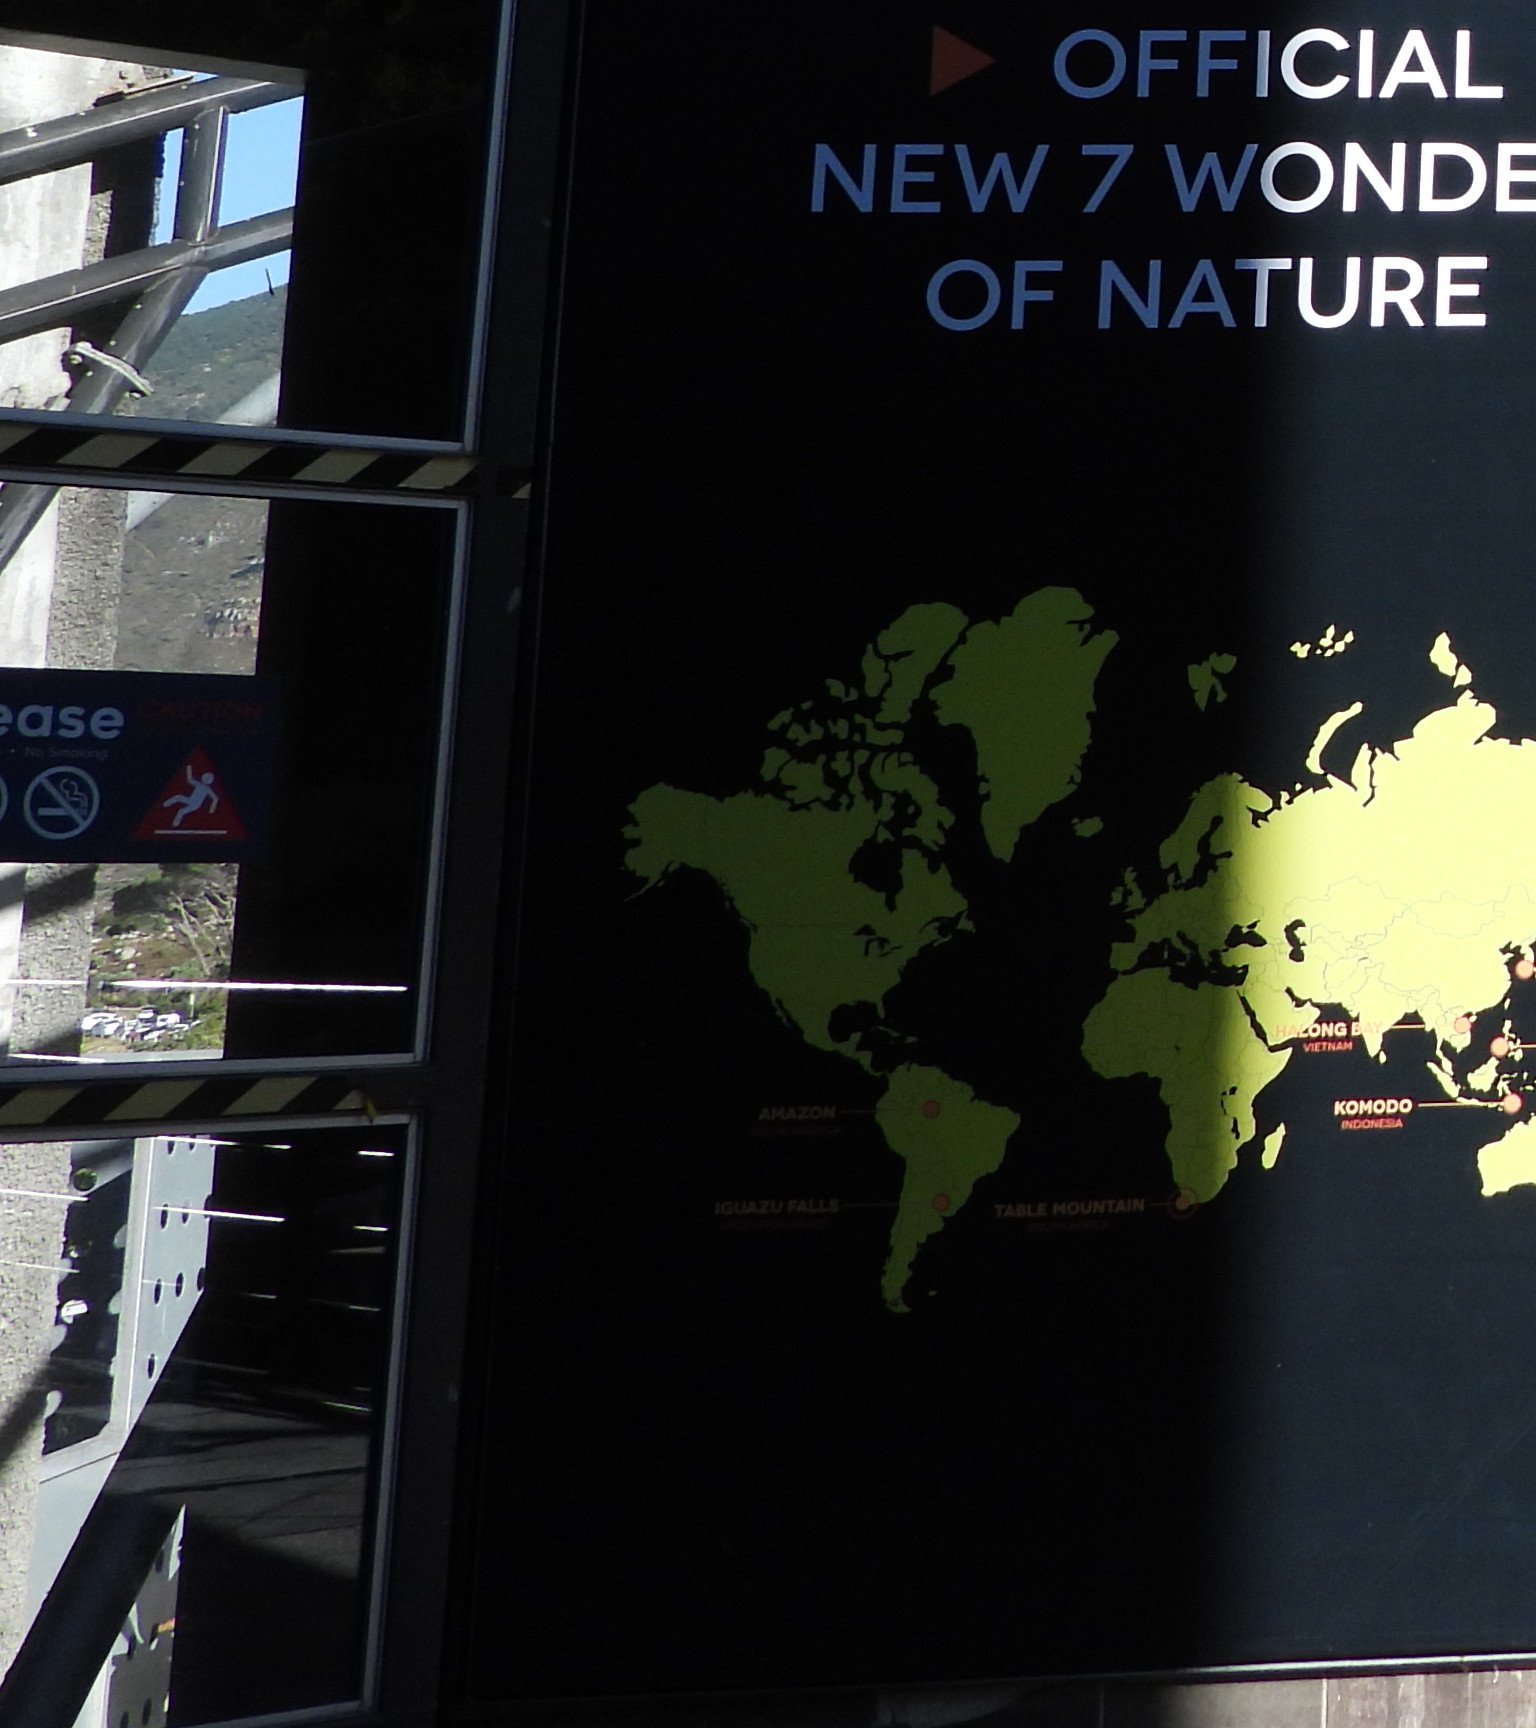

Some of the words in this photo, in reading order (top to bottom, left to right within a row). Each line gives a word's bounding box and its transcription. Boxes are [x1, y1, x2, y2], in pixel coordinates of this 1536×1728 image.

[1053, 27, 1504, 101] OFFICIAL
[811, 143, 1050, 214] NEW
[1080, 144, 1134, 214] 7
[926, 258, 1063, 332] OF
[1098, 256, 1489, 330] NATURE
[1275, 1021, 1348, 1038] HALONG
[1351, 1021, 1383, 1037] BAY
[1303, 1041, 1353, 1052] VIETNAM
[758, 1105, 837, 1121] AMAZON
[1334, 1099, 1413, 1115] KOMODO
[1341, 1119, 1403, 1130] INDONESIA
[715, 1199, 784, 1216] IGUAZU
[786, 1198, 840, 1214] FALLS
[993, 1203, 1048, 1218] TABLE
[1052, 1198, 1146, 1216] MOUNTAIN
